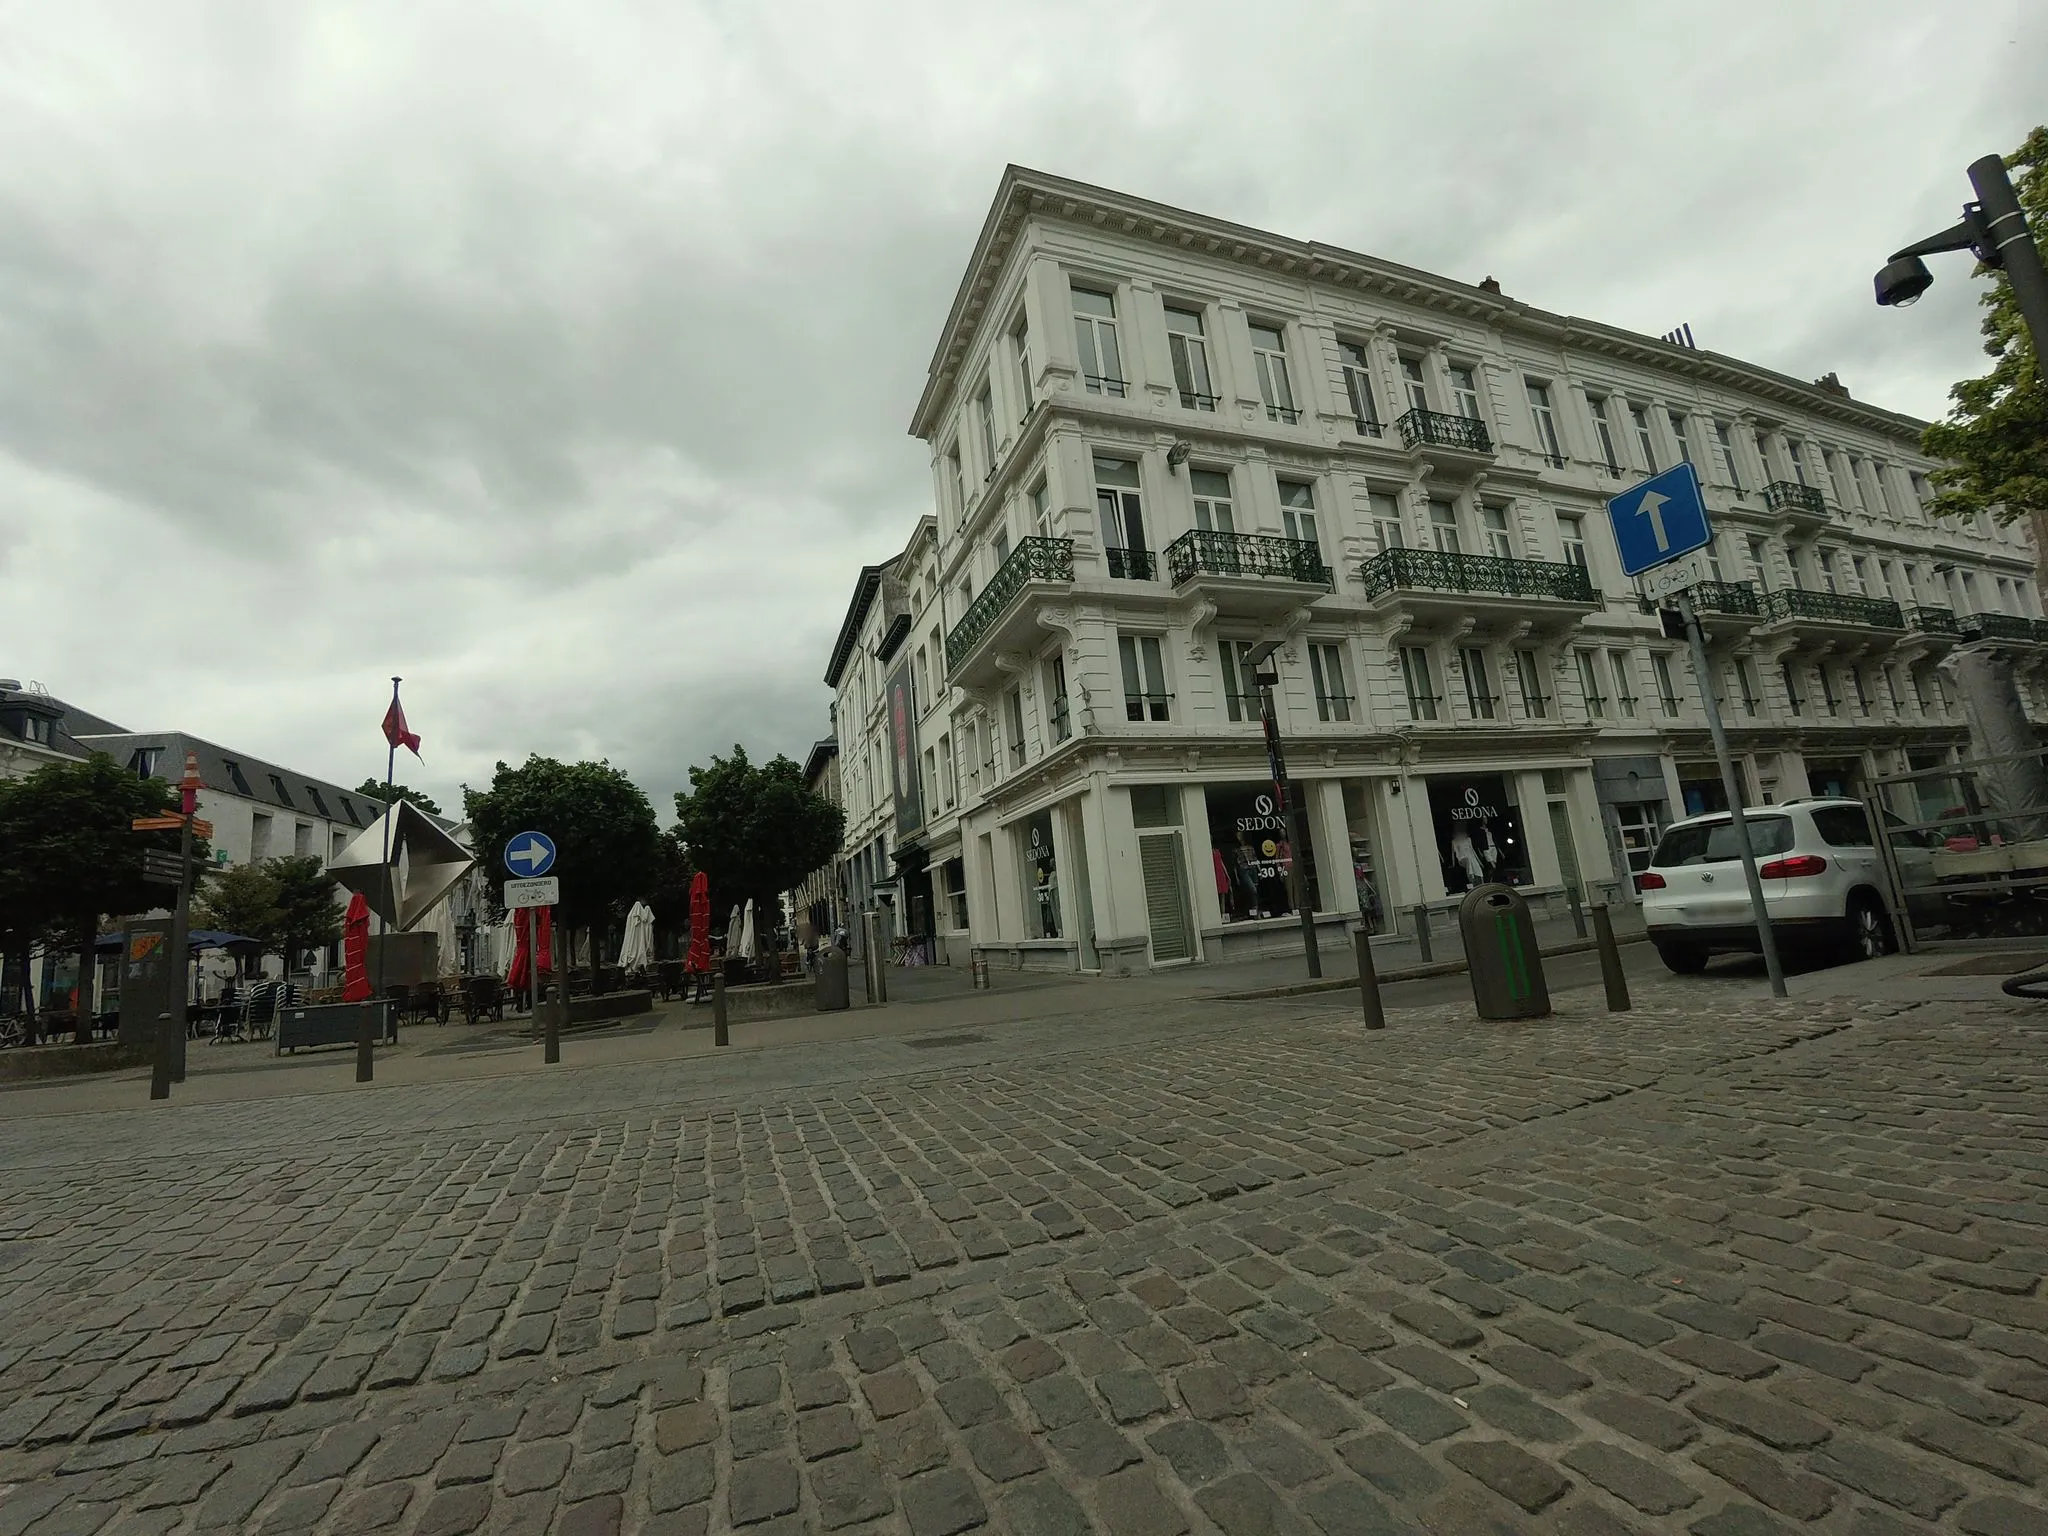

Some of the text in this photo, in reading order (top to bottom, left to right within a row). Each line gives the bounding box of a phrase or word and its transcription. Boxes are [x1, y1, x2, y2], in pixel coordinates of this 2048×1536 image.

[1451, 806, 1498, 820] SEDONA
[1236, 816, 1286, 831] SEDON
[1026, 845, 1050, 861] SEDONA
[1258, 865, 1288, 878] -30 %
[510, 880, 552, 889] UITGEZONDERD
